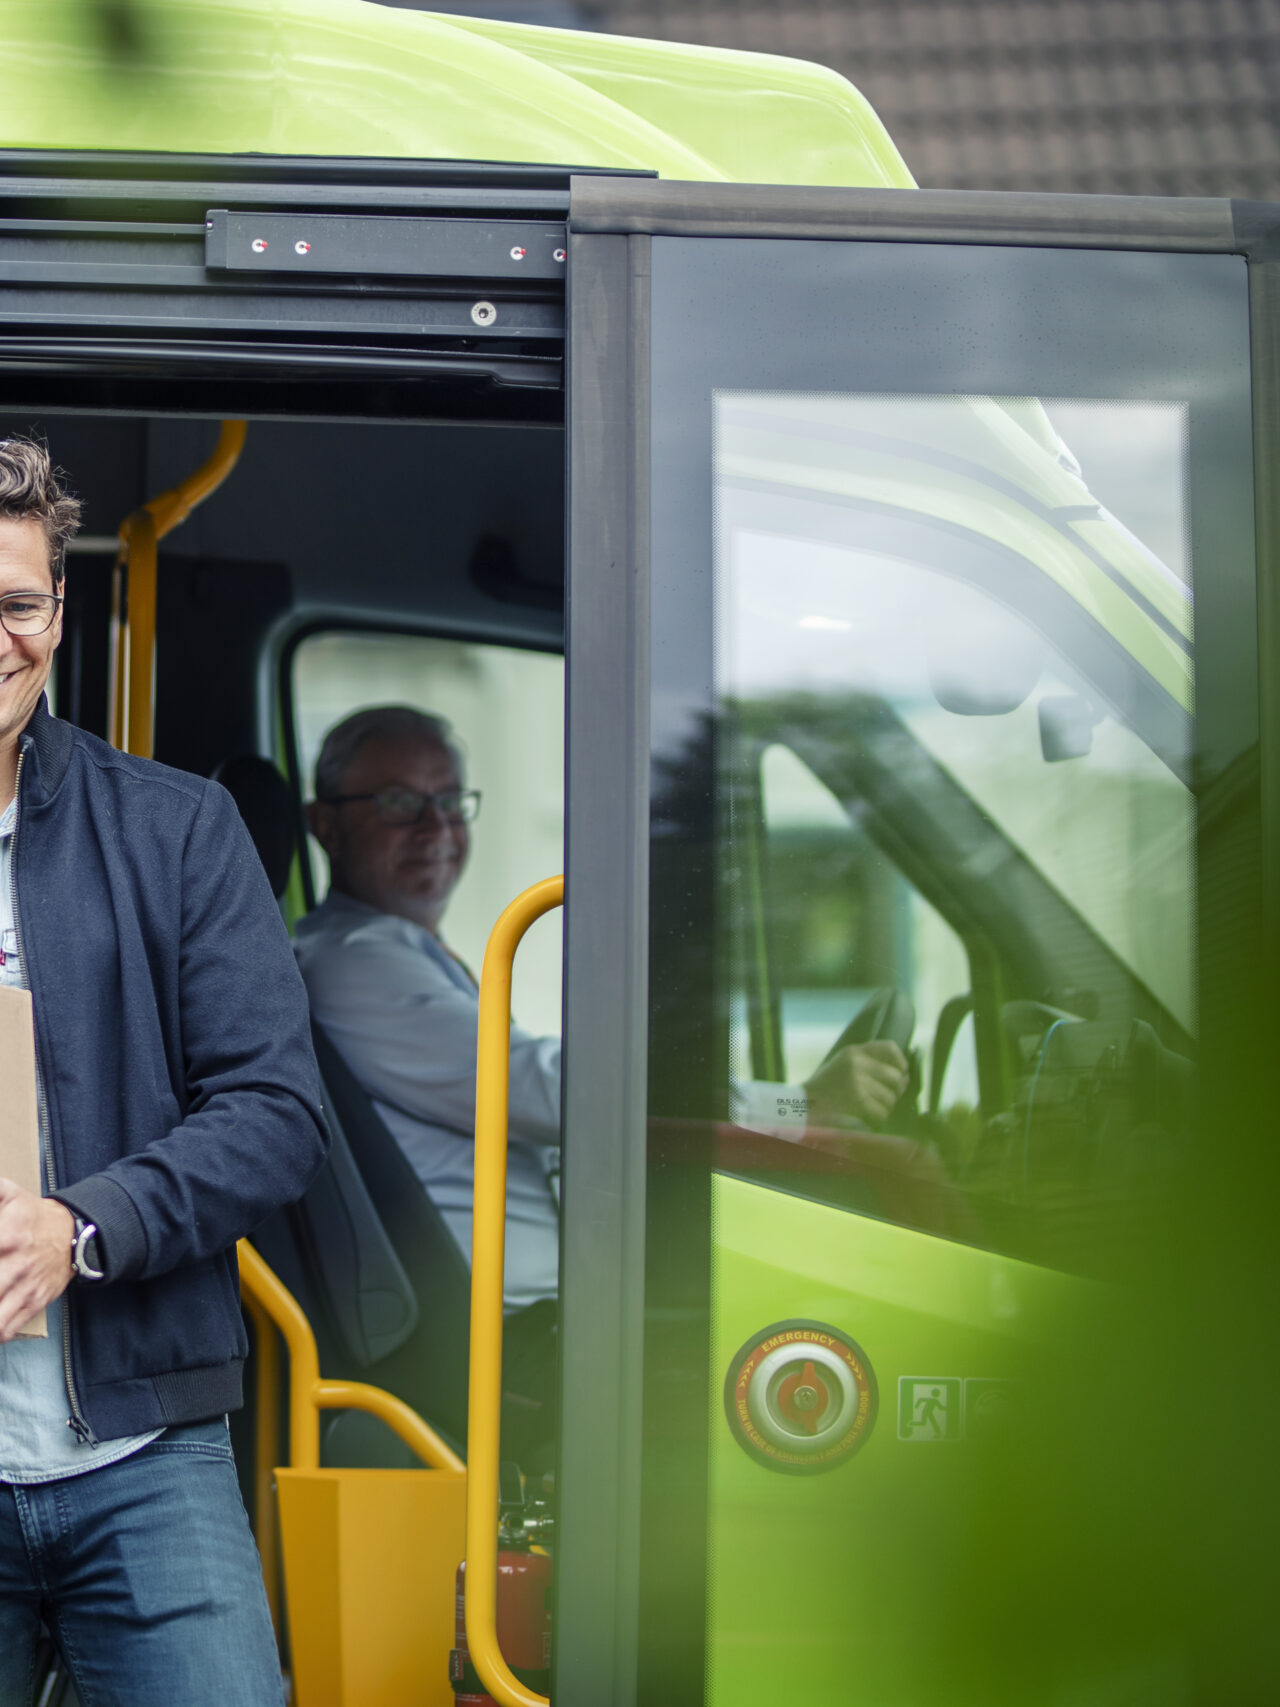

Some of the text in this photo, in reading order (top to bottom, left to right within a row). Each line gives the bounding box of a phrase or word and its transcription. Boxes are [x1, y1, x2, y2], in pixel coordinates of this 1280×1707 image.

[762, 1331, 835, 1352] EMERGENCY
[738, 1400, 749, 1420] TURN
[744, 1419, 754, 1431] IN
[749, 1430, 766, 1448] CASE
[853, 1415, 865, 1430] THE
[859, 1391, 869, 1413] DOOR
